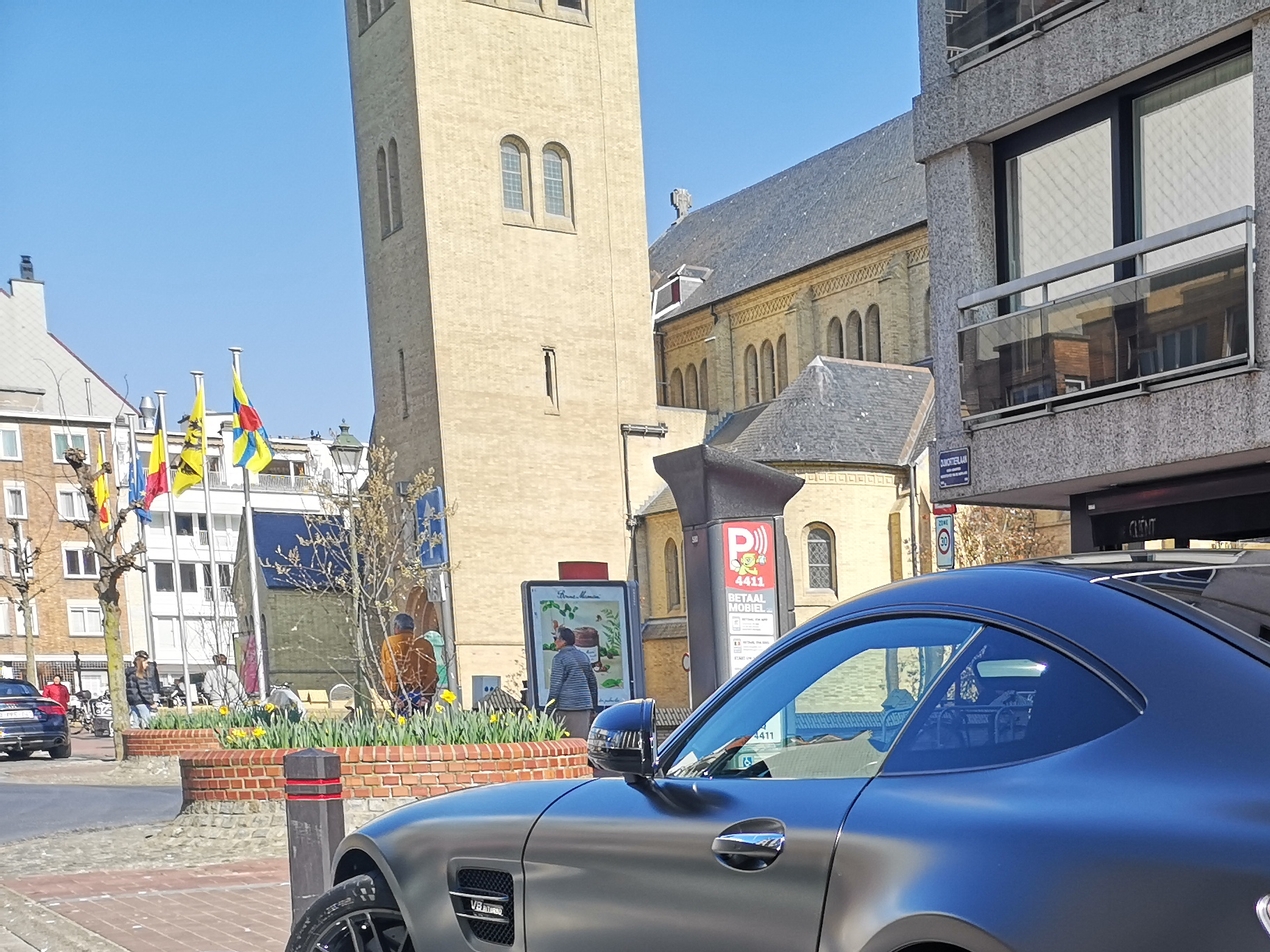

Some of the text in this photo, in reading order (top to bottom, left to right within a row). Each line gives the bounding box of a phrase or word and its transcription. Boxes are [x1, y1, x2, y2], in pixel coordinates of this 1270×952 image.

[940, 537, 947, 547] 30
[735, 575, 765, 587] 4411
[728, 592, 766, 603] BETAAL
[729, 603, 765, 613] MOBIEL
[470, 899, 483, 911] V8
